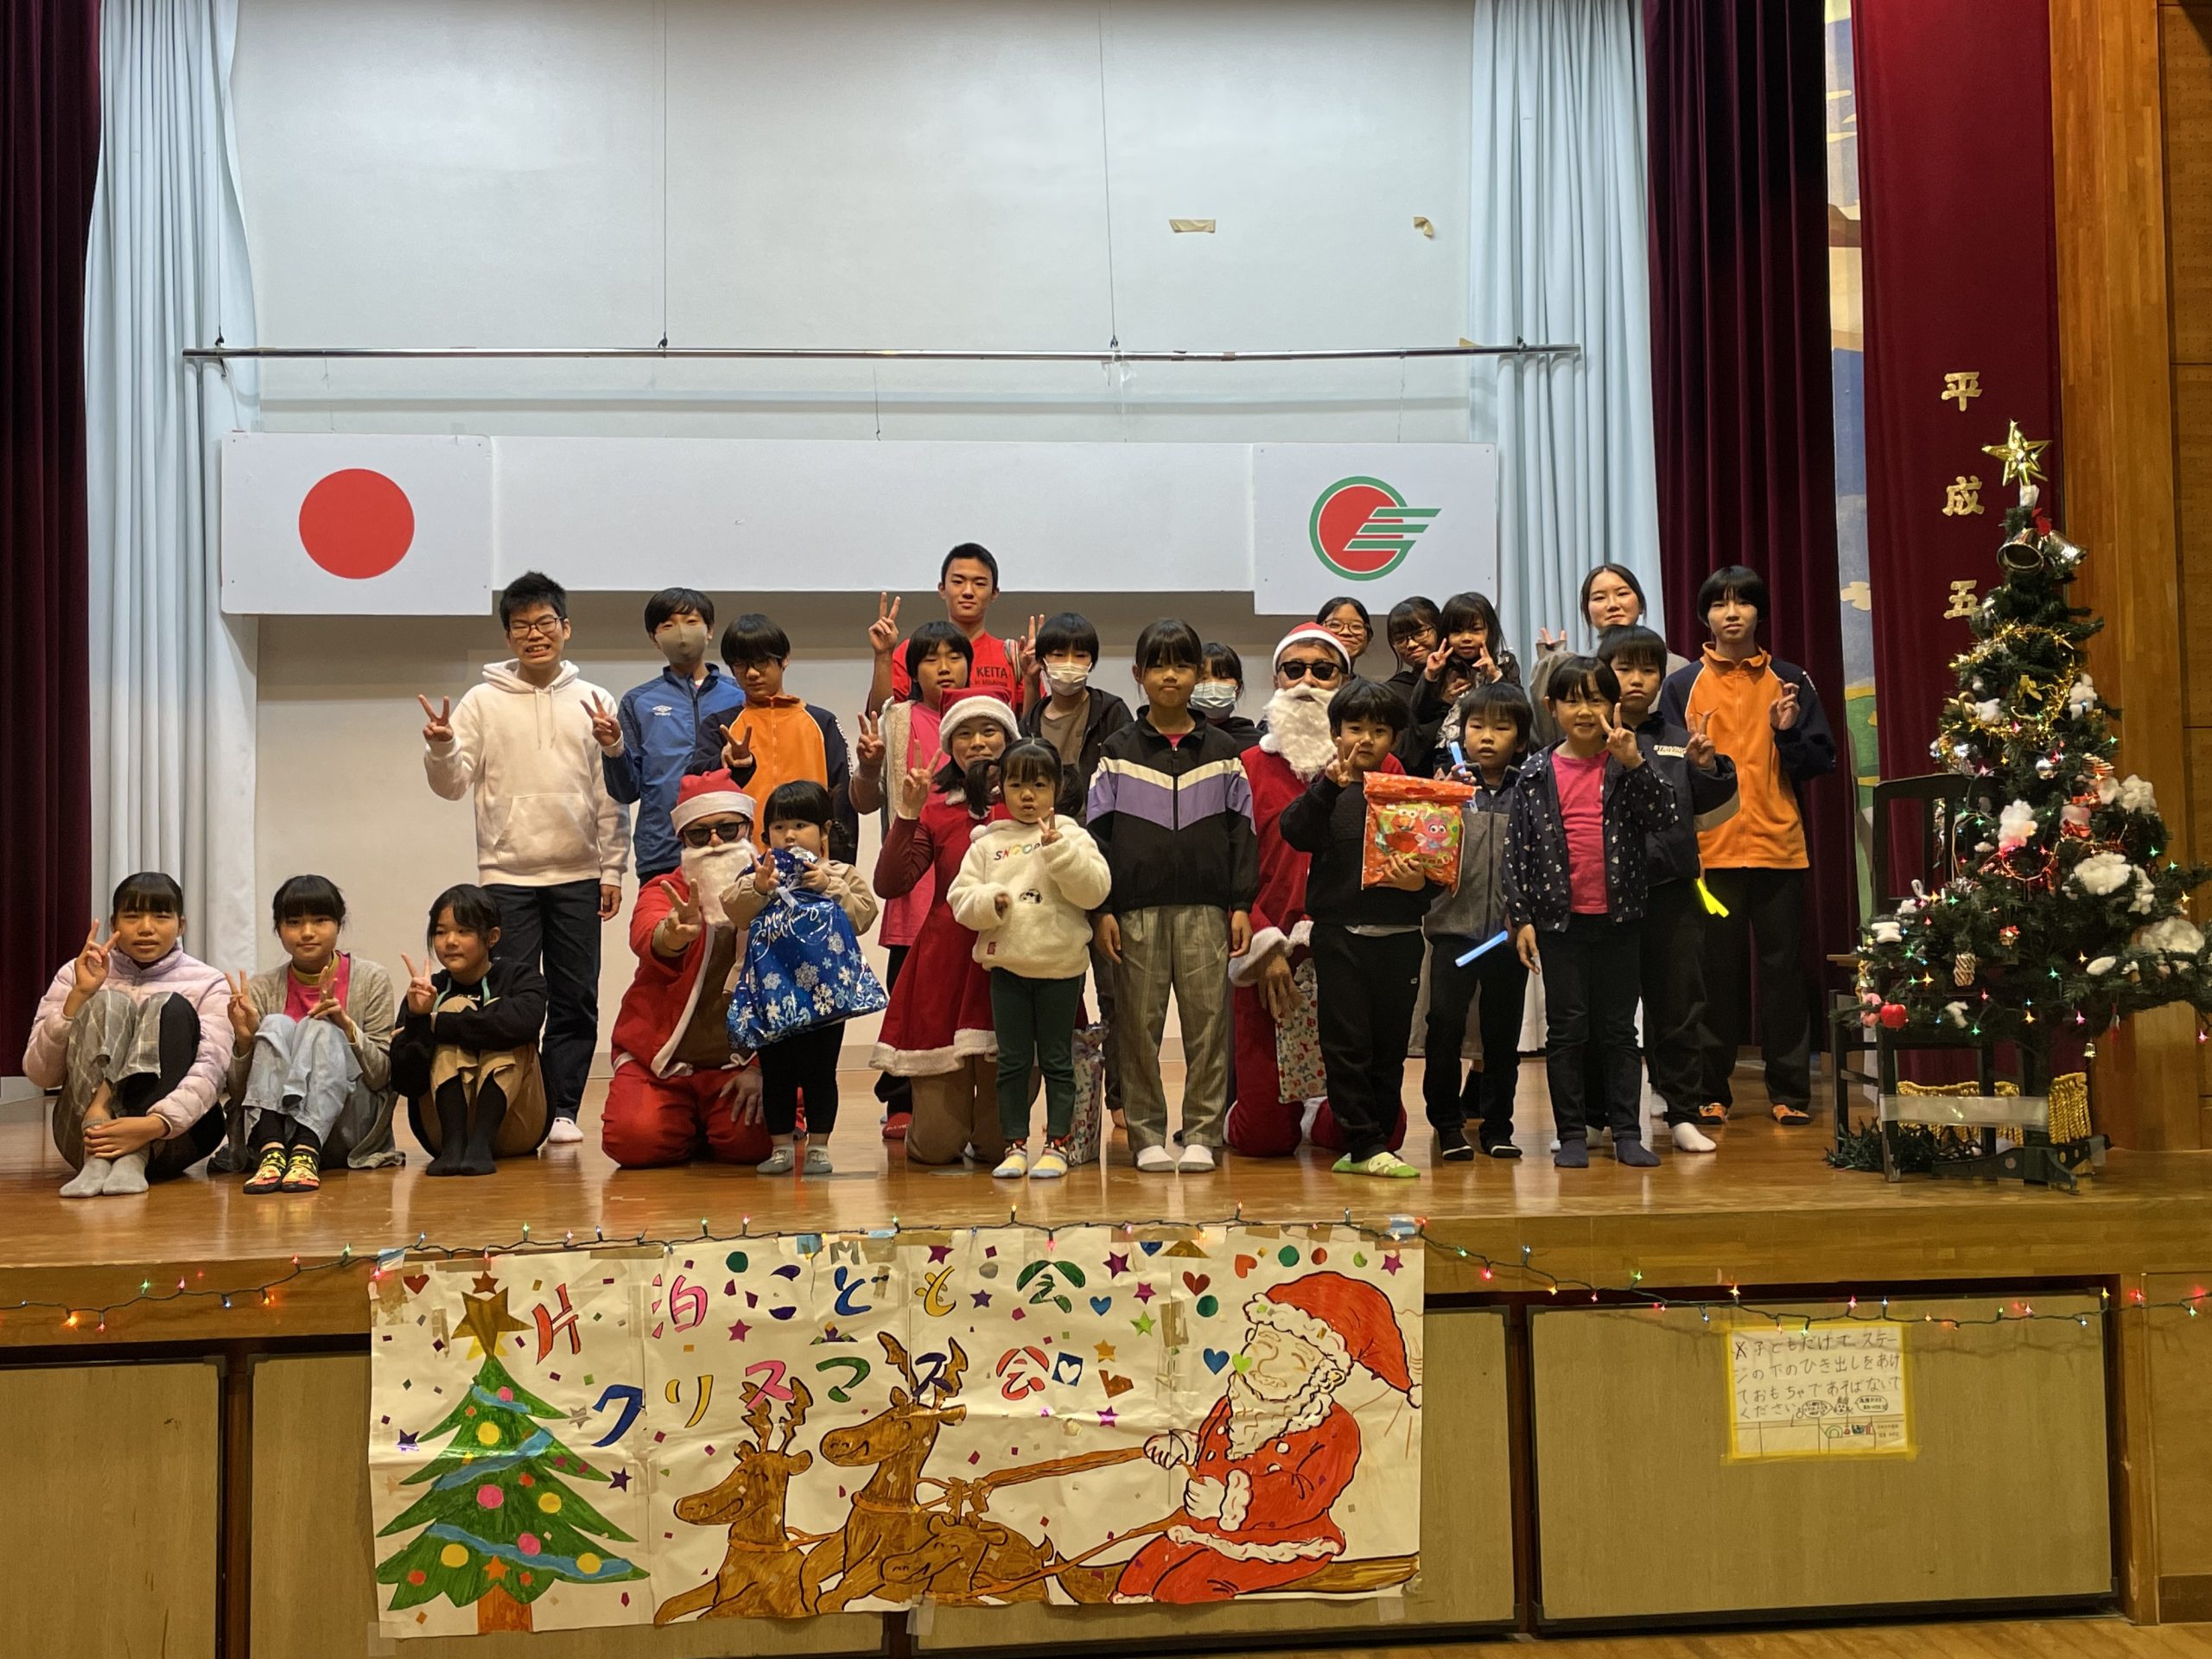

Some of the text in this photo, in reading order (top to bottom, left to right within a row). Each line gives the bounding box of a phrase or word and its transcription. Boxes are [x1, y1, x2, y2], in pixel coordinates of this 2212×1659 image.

[976, 665, 1008, 679] KEITA
[994, 842, 1041, 861] SNOOP
[591, 1345, 1050, 1447] クリスマス会
